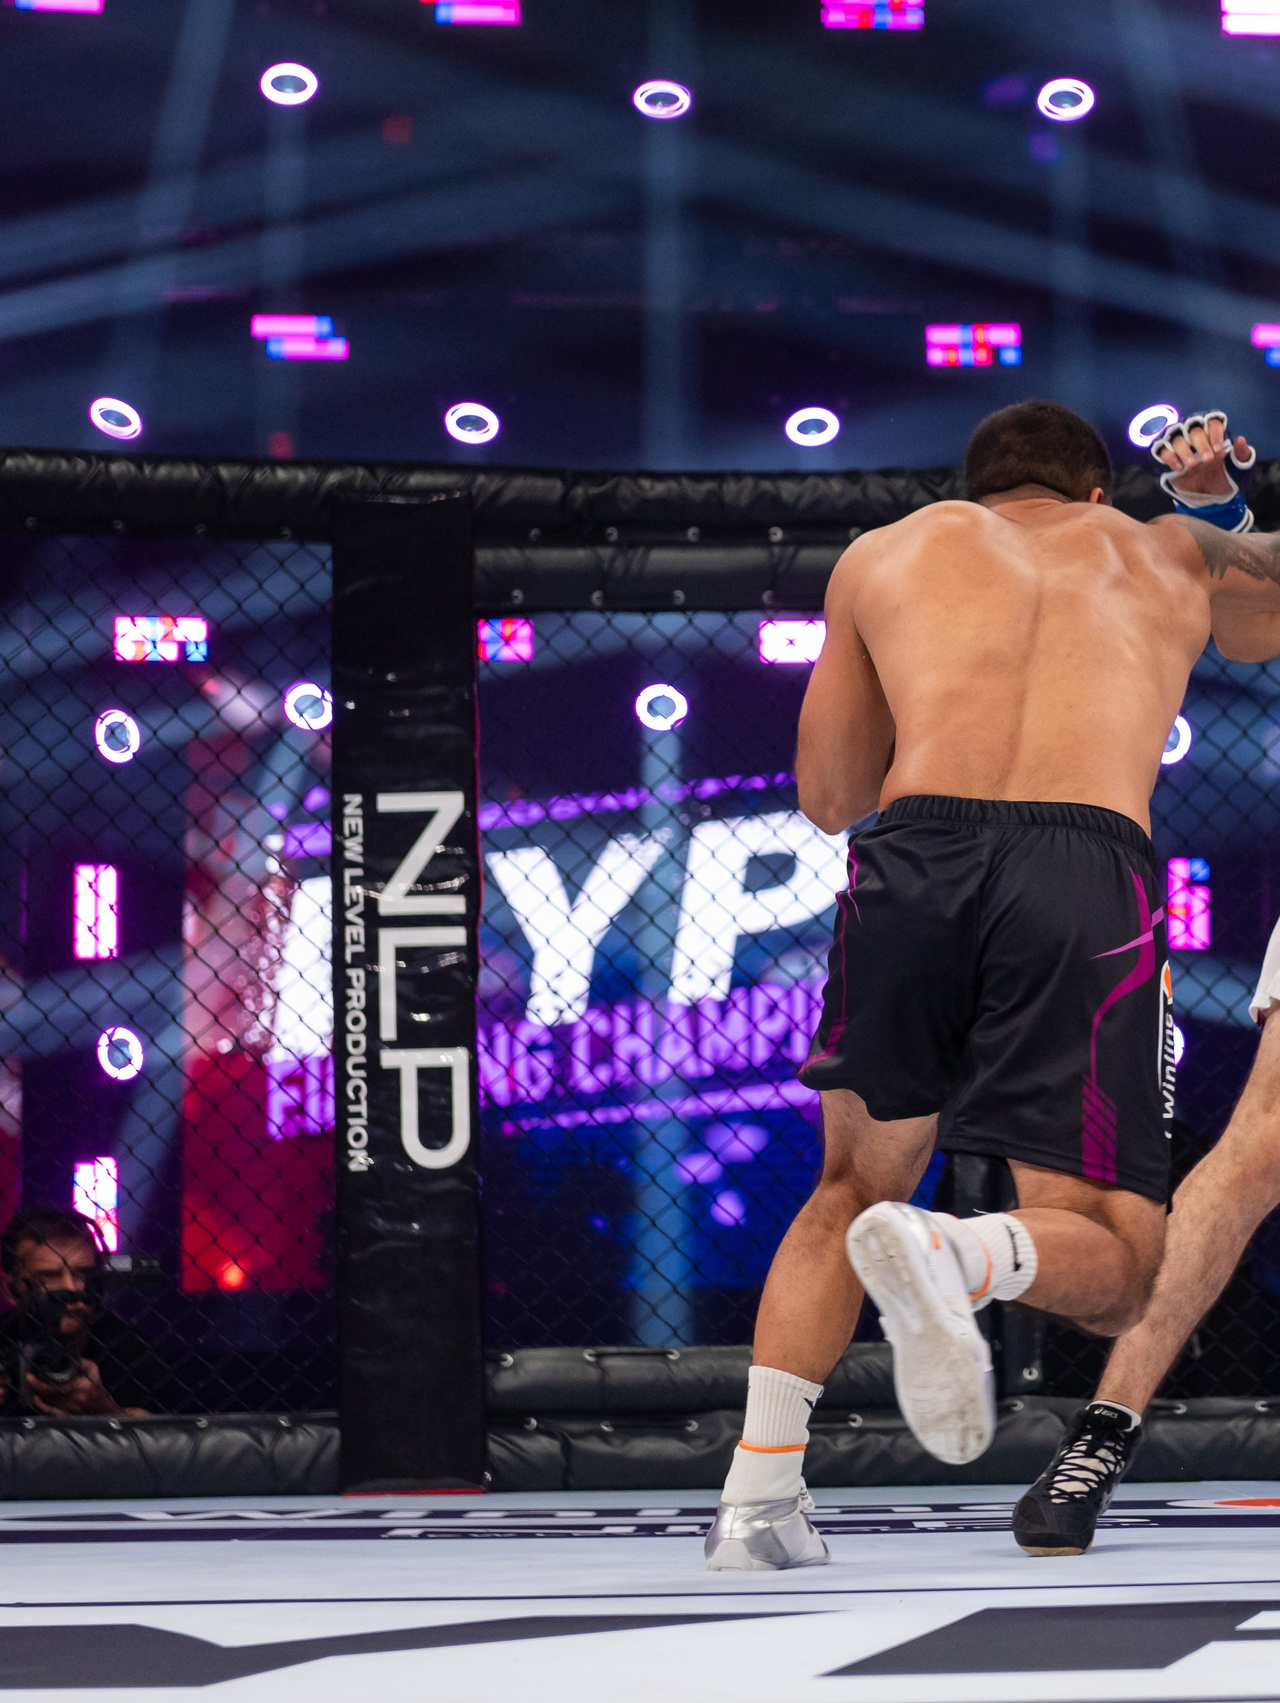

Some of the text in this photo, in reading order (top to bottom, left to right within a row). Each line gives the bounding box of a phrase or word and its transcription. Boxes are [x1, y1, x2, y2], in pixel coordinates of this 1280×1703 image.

[343, 793, 370, 1172] NEW LEVEL PRODUCTION
[376, 790, 472, 1170] NLP
